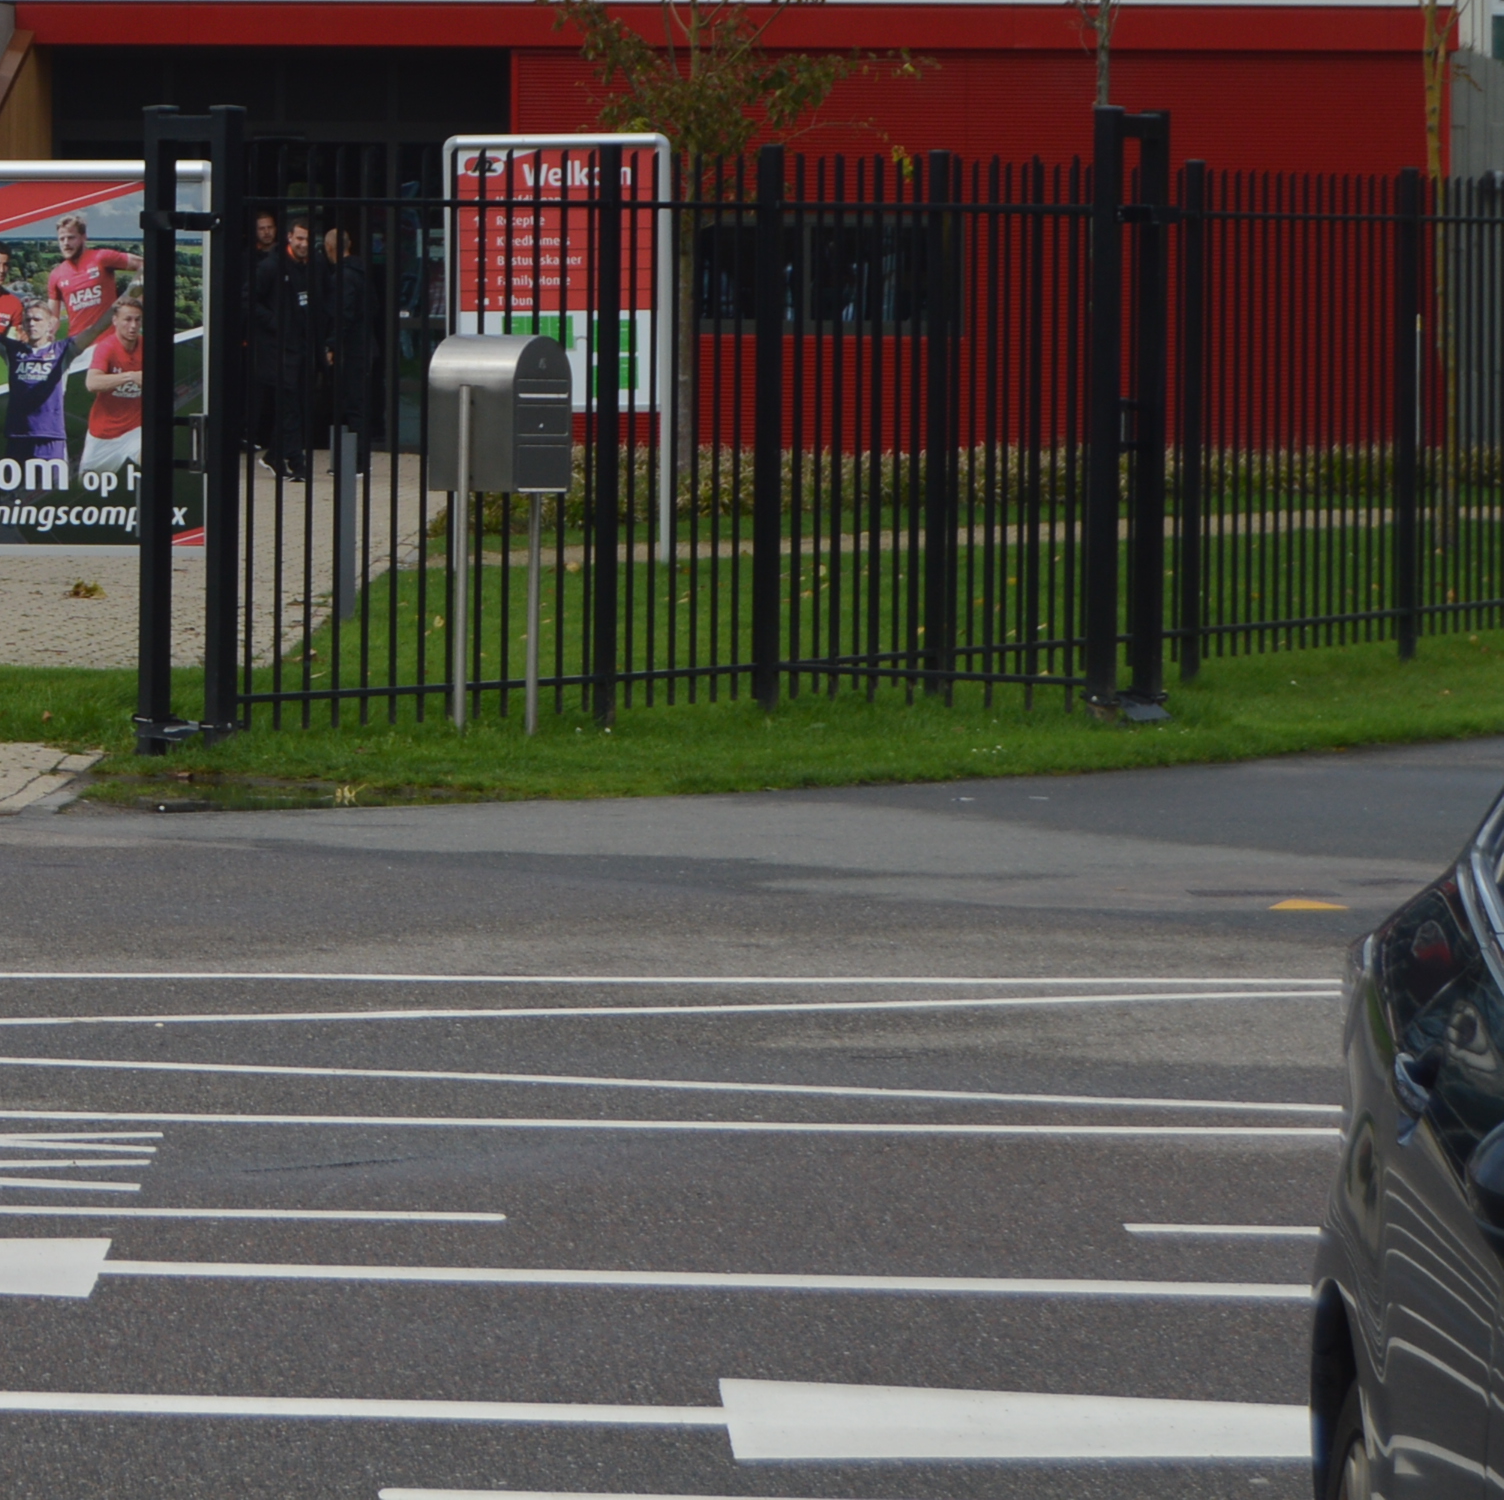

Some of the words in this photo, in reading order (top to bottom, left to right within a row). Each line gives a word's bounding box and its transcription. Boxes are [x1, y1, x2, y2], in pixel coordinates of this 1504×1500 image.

[69, 285, 102, 306] AFAS
[15, 361, 53, 375] AFAS
[83, 469, 118, 498] op
